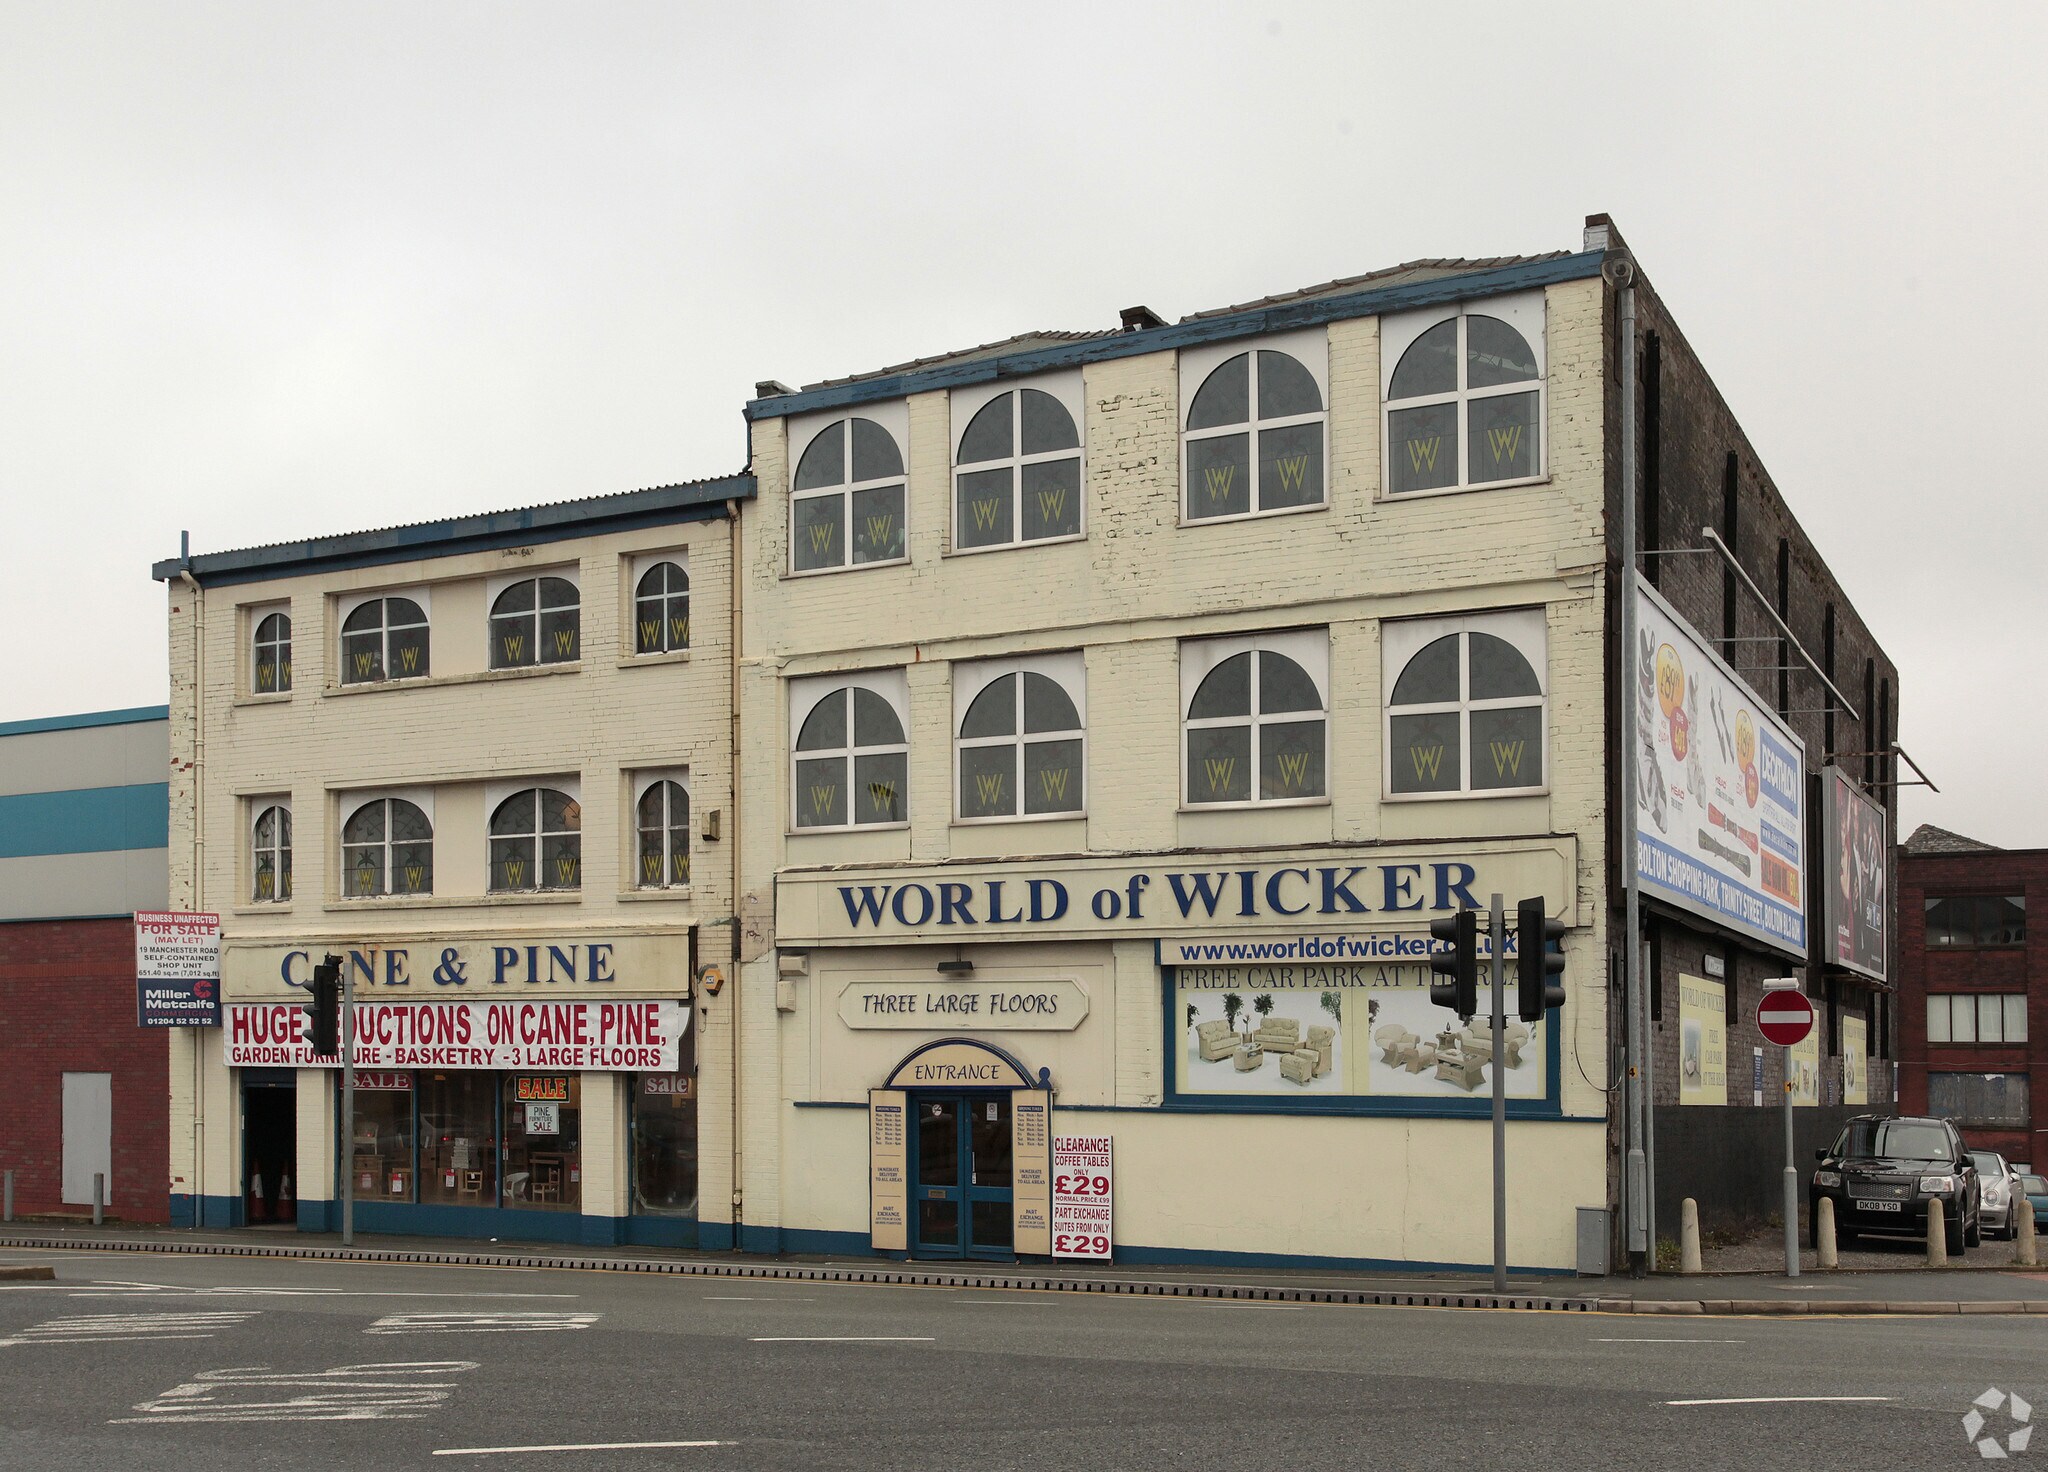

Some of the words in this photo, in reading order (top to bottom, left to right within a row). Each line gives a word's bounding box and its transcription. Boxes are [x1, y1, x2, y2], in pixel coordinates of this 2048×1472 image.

[1638, 840, 1667, 882] BOLTON
[1668, 854, 1702, 897] SHOPPING
[837, 879, 1068, 928] WORLD
[1091, 873, 1150, 920] of
[1166, 863, 1482, 918] WICKER
[138, 913, 173, 922] BUSINESS
[174, 915, 218, 924] UNAFFECTED
[141, 924, 172, 934] FOR
[177, 925, 216, 936] SALE
[155, 936, 178, 945] (MAY
[182, 937, 203, 945] LET)
[150, 946, 198, 954] MANCHESTER
[281, 949, 410, 987] CNE
[433, 947, 469, 986] &
[491, 943, 616, 984] PINE
[1179, 967, 1241, 990] FREE
[1247, 967, 1296, 989] CAR
[1302, 965, 1366, 988] PARK
[1372, 964, 1406, 987] AT
[145, 989, 191, 999] Miller
[146, 1000, 215, 1009] Metcalfe
[862, 994, 918, 1014] THREE
[926, 993, 980, 1015] LARGE
[990, 993, 1058, 1014] FLOORS
[231, 1006, 303, 1044] HUGE
[487, 1004, 514, 1046] ON
[520, 1004, 595, 1047] CANE,
[601, 1003, 667, 1047] PINE,
[232, 1046, 290, 1063] GARDEN
[395, 1047, 496, 1066] BASKETRY
[527, 1047, 584, 1066] LARGE
[590, 1048, 661, 1067] FLOORS
[914, 1063, 1000, 1081] ENTRANCE
[518, 1077, 567, 1099] SALE
[646, 1075, 688, 1093] sale
[533, 1106, 551, 1117] PINE
[533, 1121, 552, 1131] SALE
[1054, 1137, 1109, 1152] CLEARANCE
[1054, 1155, 1081, 1166] COFFEE
[1083, 1156, 1109, 1167] TABLES
[1073, 1168, 1089, 1176] ONLY
[1055, 1175, 1110, 1196] £29
[1859, 1201, 1880, 1210] DK08
[1054, 1207, 1072, 1219] PART
[1073, 1208, 1109, 1220] EXCHANGE
[1054, 1221, 1075, 1232] SUITES
[1076, 1222, 1092, 1233] FROM
[1093, 1223, 1110, 1234] ONLY
[1055, 1234, 1110, 1255] £29
